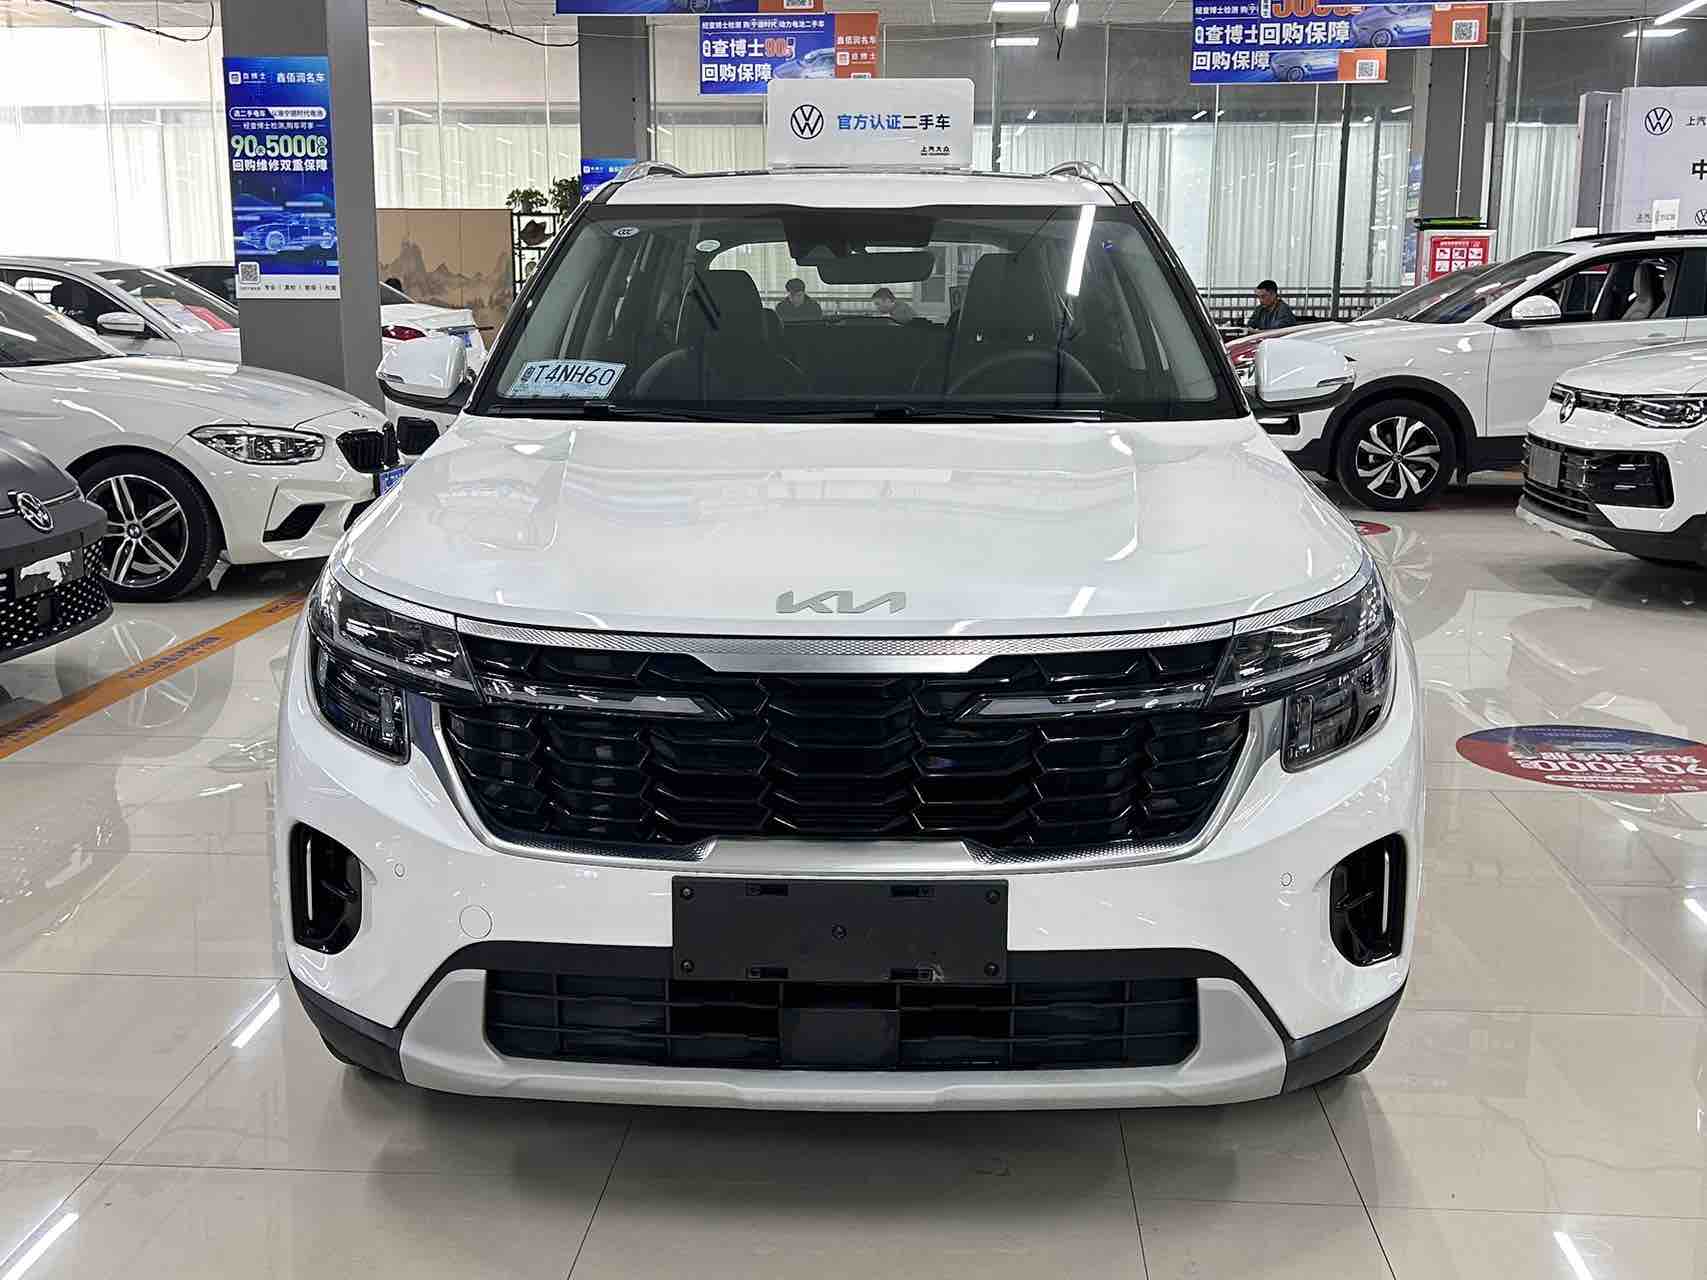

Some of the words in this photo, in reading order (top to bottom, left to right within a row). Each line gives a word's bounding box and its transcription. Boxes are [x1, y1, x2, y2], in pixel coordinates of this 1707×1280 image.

[1192, 50, 1271, 71] 回购保障
[701, 63, 772, 82] 回购保障
[837, 114, 951, 131] 官方认证二手车
[232, 159, 328, 172] 回购维修双重保障
